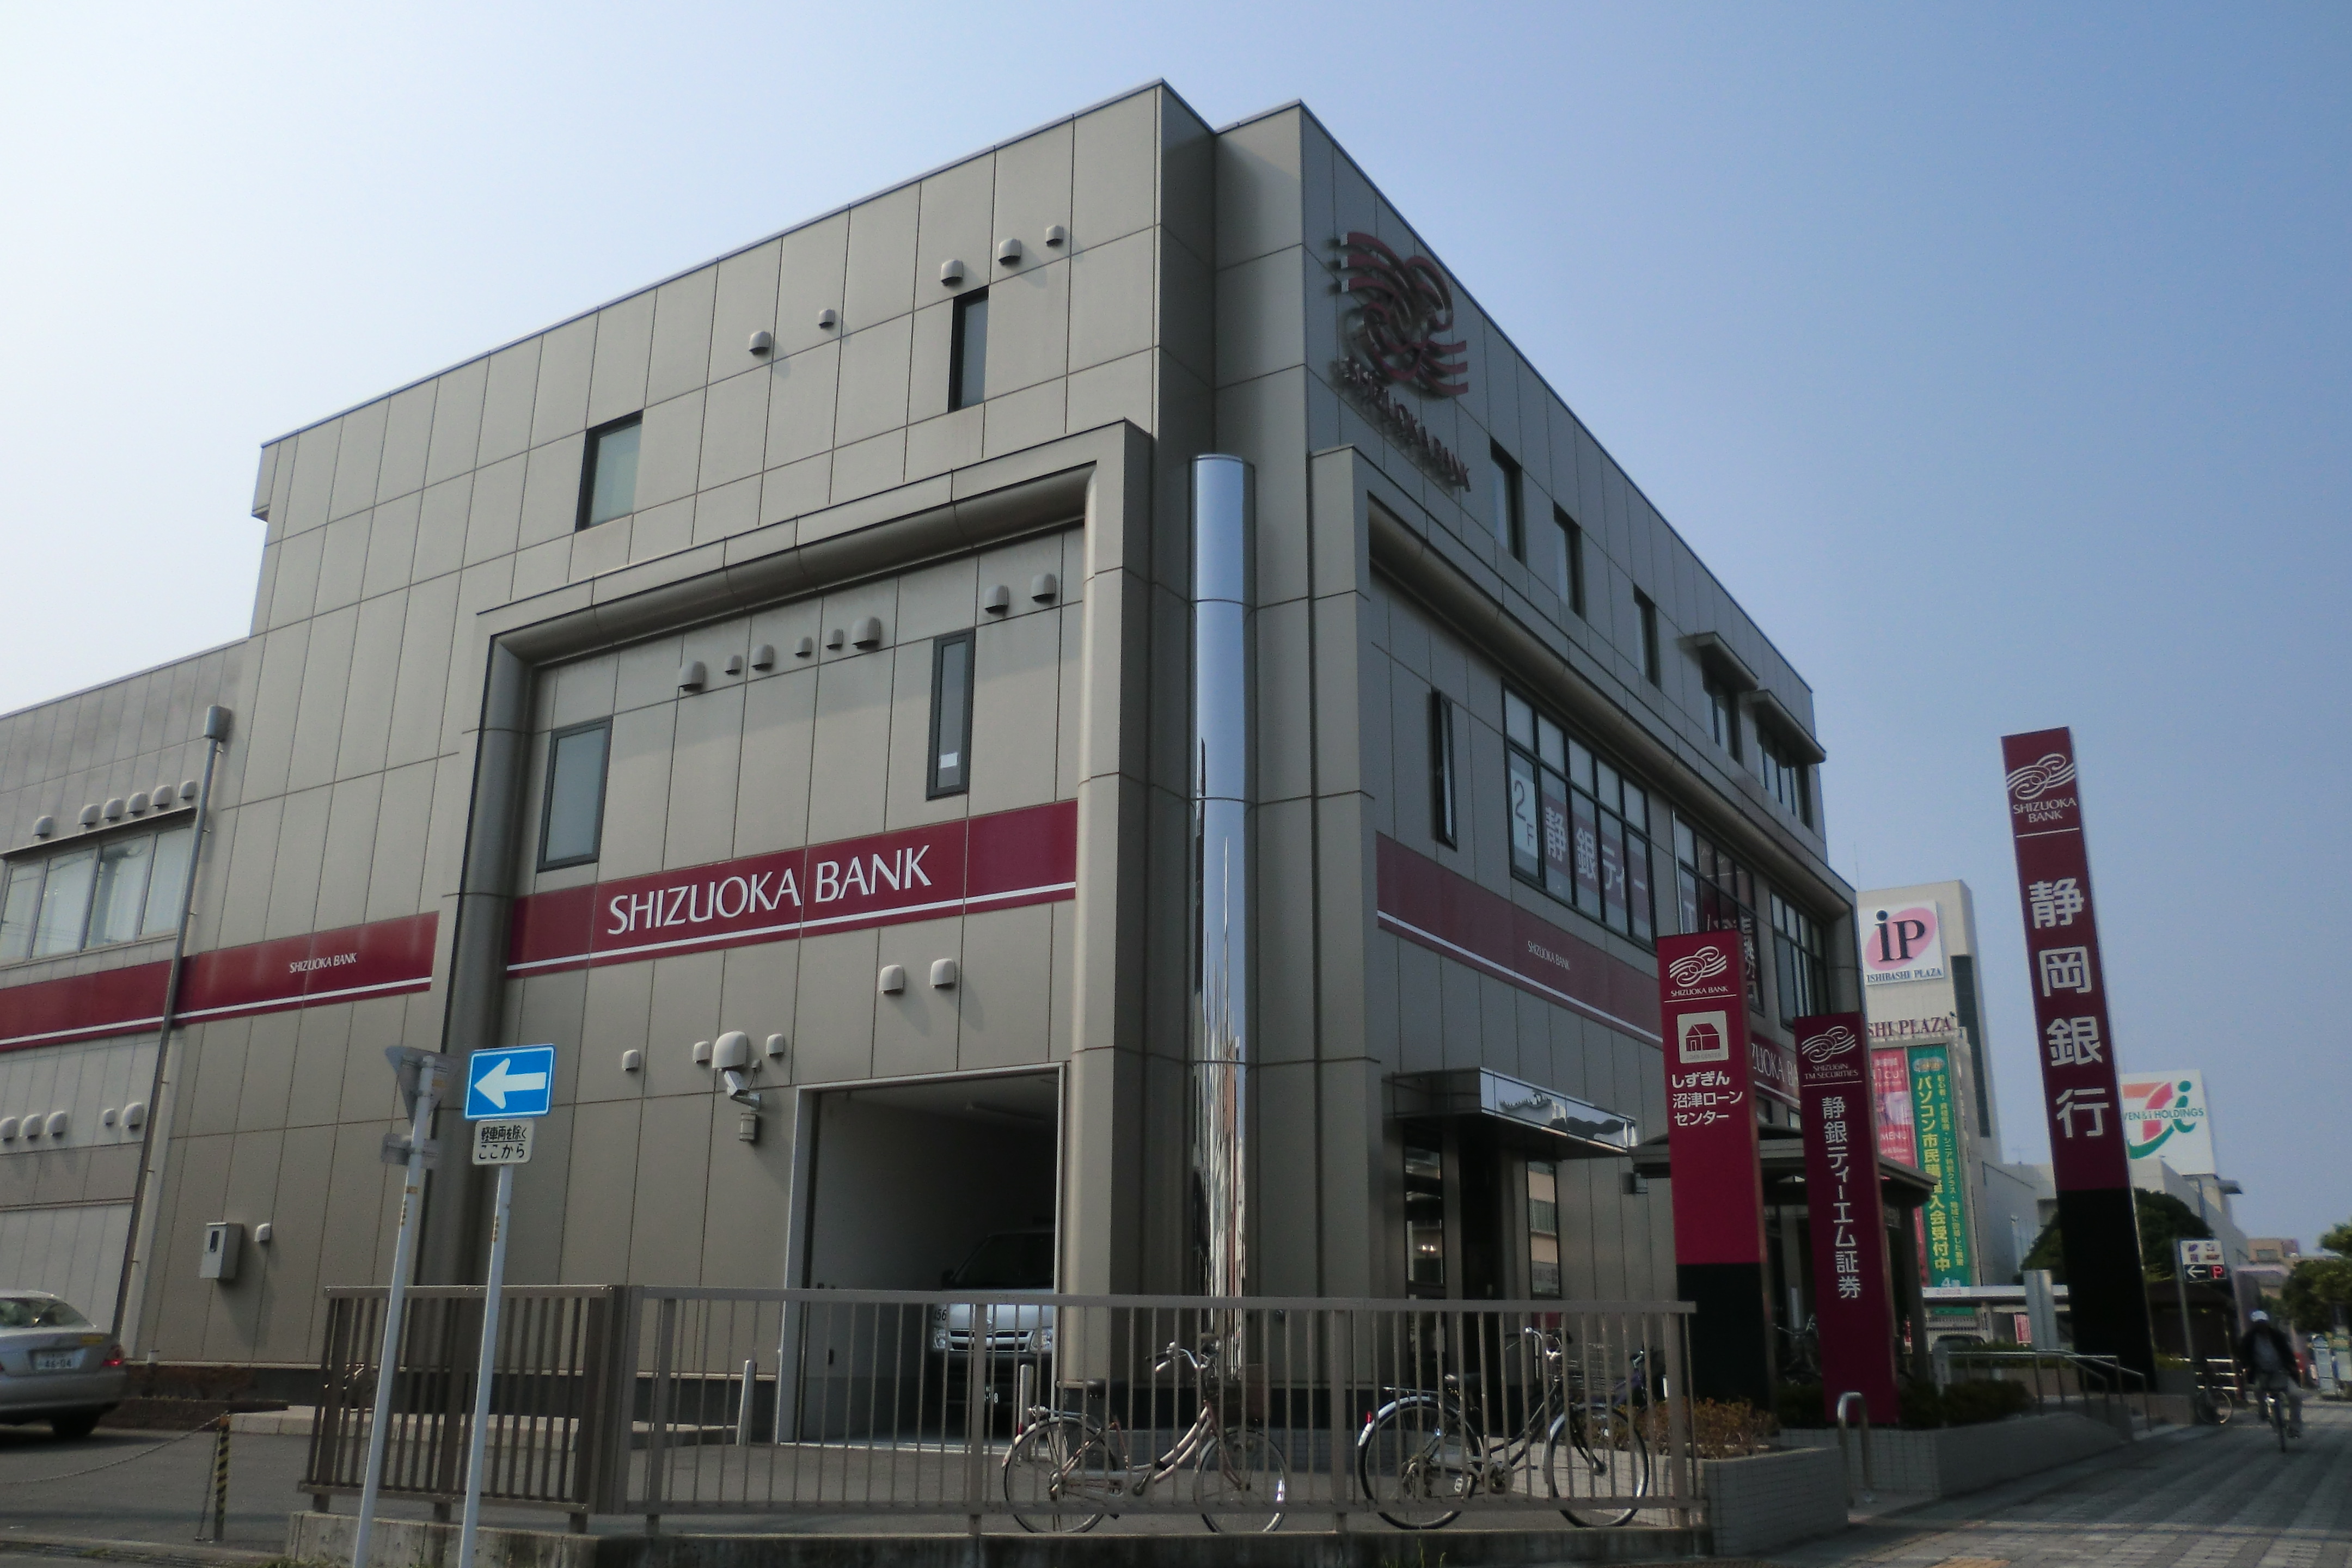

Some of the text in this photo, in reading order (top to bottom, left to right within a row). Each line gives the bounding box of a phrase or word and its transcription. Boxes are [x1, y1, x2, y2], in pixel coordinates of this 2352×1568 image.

[2013, 797, 2077, 814] SHIZUOKA
[2028, 810, 2063, 823] BANK
[607, 844, 932, 935] SHIZUOKA BANK
[289, 953, 357, 973] SHIZUOKA BANK
[1867, 967, 1942, 982] ISHIBASHI PLAZA
[1670, 985, 1729, 997] SHIZUOKA BANK
[2028, 878, 2110, 1138] 静岡銀行
[1867, 1016, 1952, 1037] SHI PLAZA
[1813, 1063, 1848, 1072] SHIZUGIN
[1817, 1069, 1859, 1079] SECURITIES
[1671, 1070, 1730, 1088] しずぎん
[1673, 1091, 1743, 1108] 沼津ローン
[1674, 1111, 1729, 1126] センター
[2154, 1107, 2204, 1119] HOLDINGS
[481, 1125, 526, 1142] 軽車両を除く
[479, 1143, 525, 1159] ここから
[1822, 1096, 1861, 1299] 静銀ティーエム証券
[2213, 1265, 2224, 1279] P
